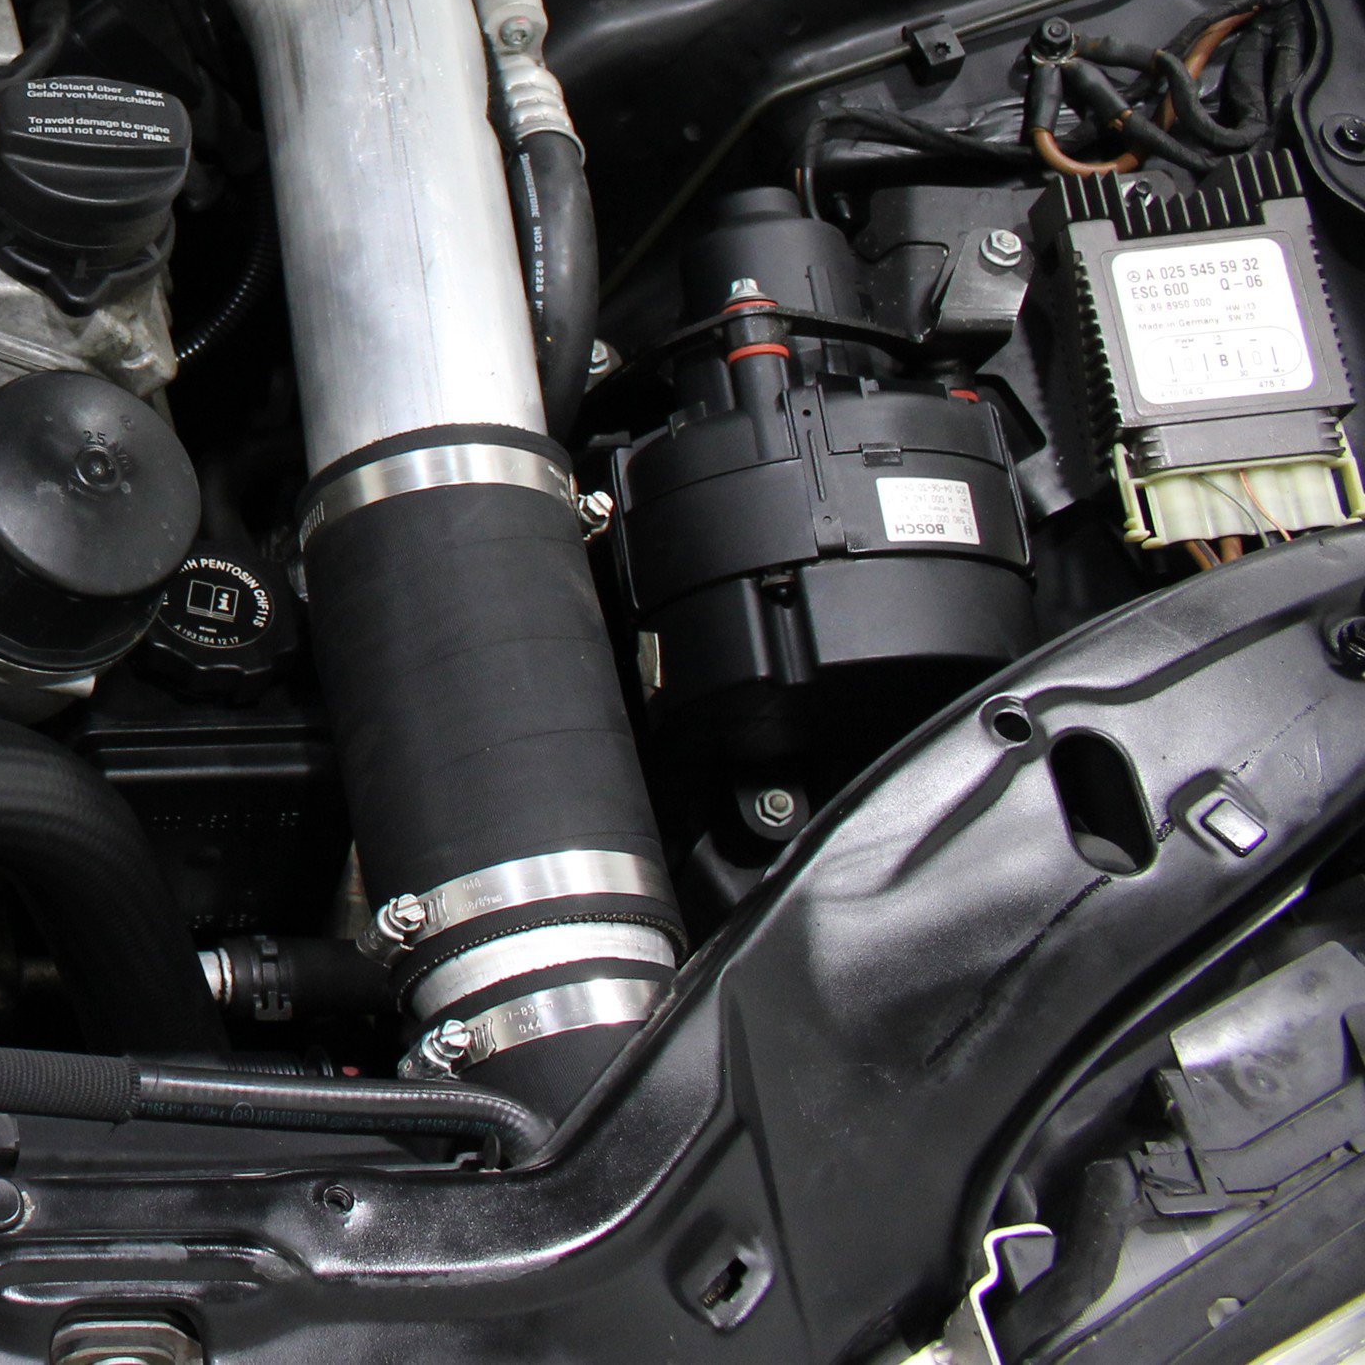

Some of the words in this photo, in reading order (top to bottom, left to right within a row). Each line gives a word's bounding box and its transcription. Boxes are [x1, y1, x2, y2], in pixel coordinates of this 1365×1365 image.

[26, 90, 64, 99] Gefahr
[87, 92, 166, 108] Motorschäden
[27, 82, 47, 90] Bei
[49, 81, 94, 92] Ölstand
[96, 84, 122, 94] über
[135, 89, 164, 100] max
[27, 116, 43, 125] To
[44, 116, 75, 125] avoid
[75, 117, 120, 129] damage
[121, 121, 133, 130] to
[133, 123, 171, 135] engine
[27, 125, 43, 134] oil
[44, 126, 73, 134] must
[95, 128, 138, 139] exceed
[141, 132, 172, 144] max
[1146, 269, 1155, 281] A
[1160, 265, 1186, 280] 025
[1189, 262, 1216, 277] 545
[1219, 259, 1237, 274] 59
[1241, 257, 1259, 271] 32
[1131, 286, 1159, 300] ESG
[1163, 282, 1190, 297] 600
[1138, 322, 1164, 331] Made
[1178, 317, 1220, 330] Germany
[895, 523, 946, 535] BOSCH
[199, 558, 260, 590] PENTOSIN
[198, 634, 216, 645] 584
